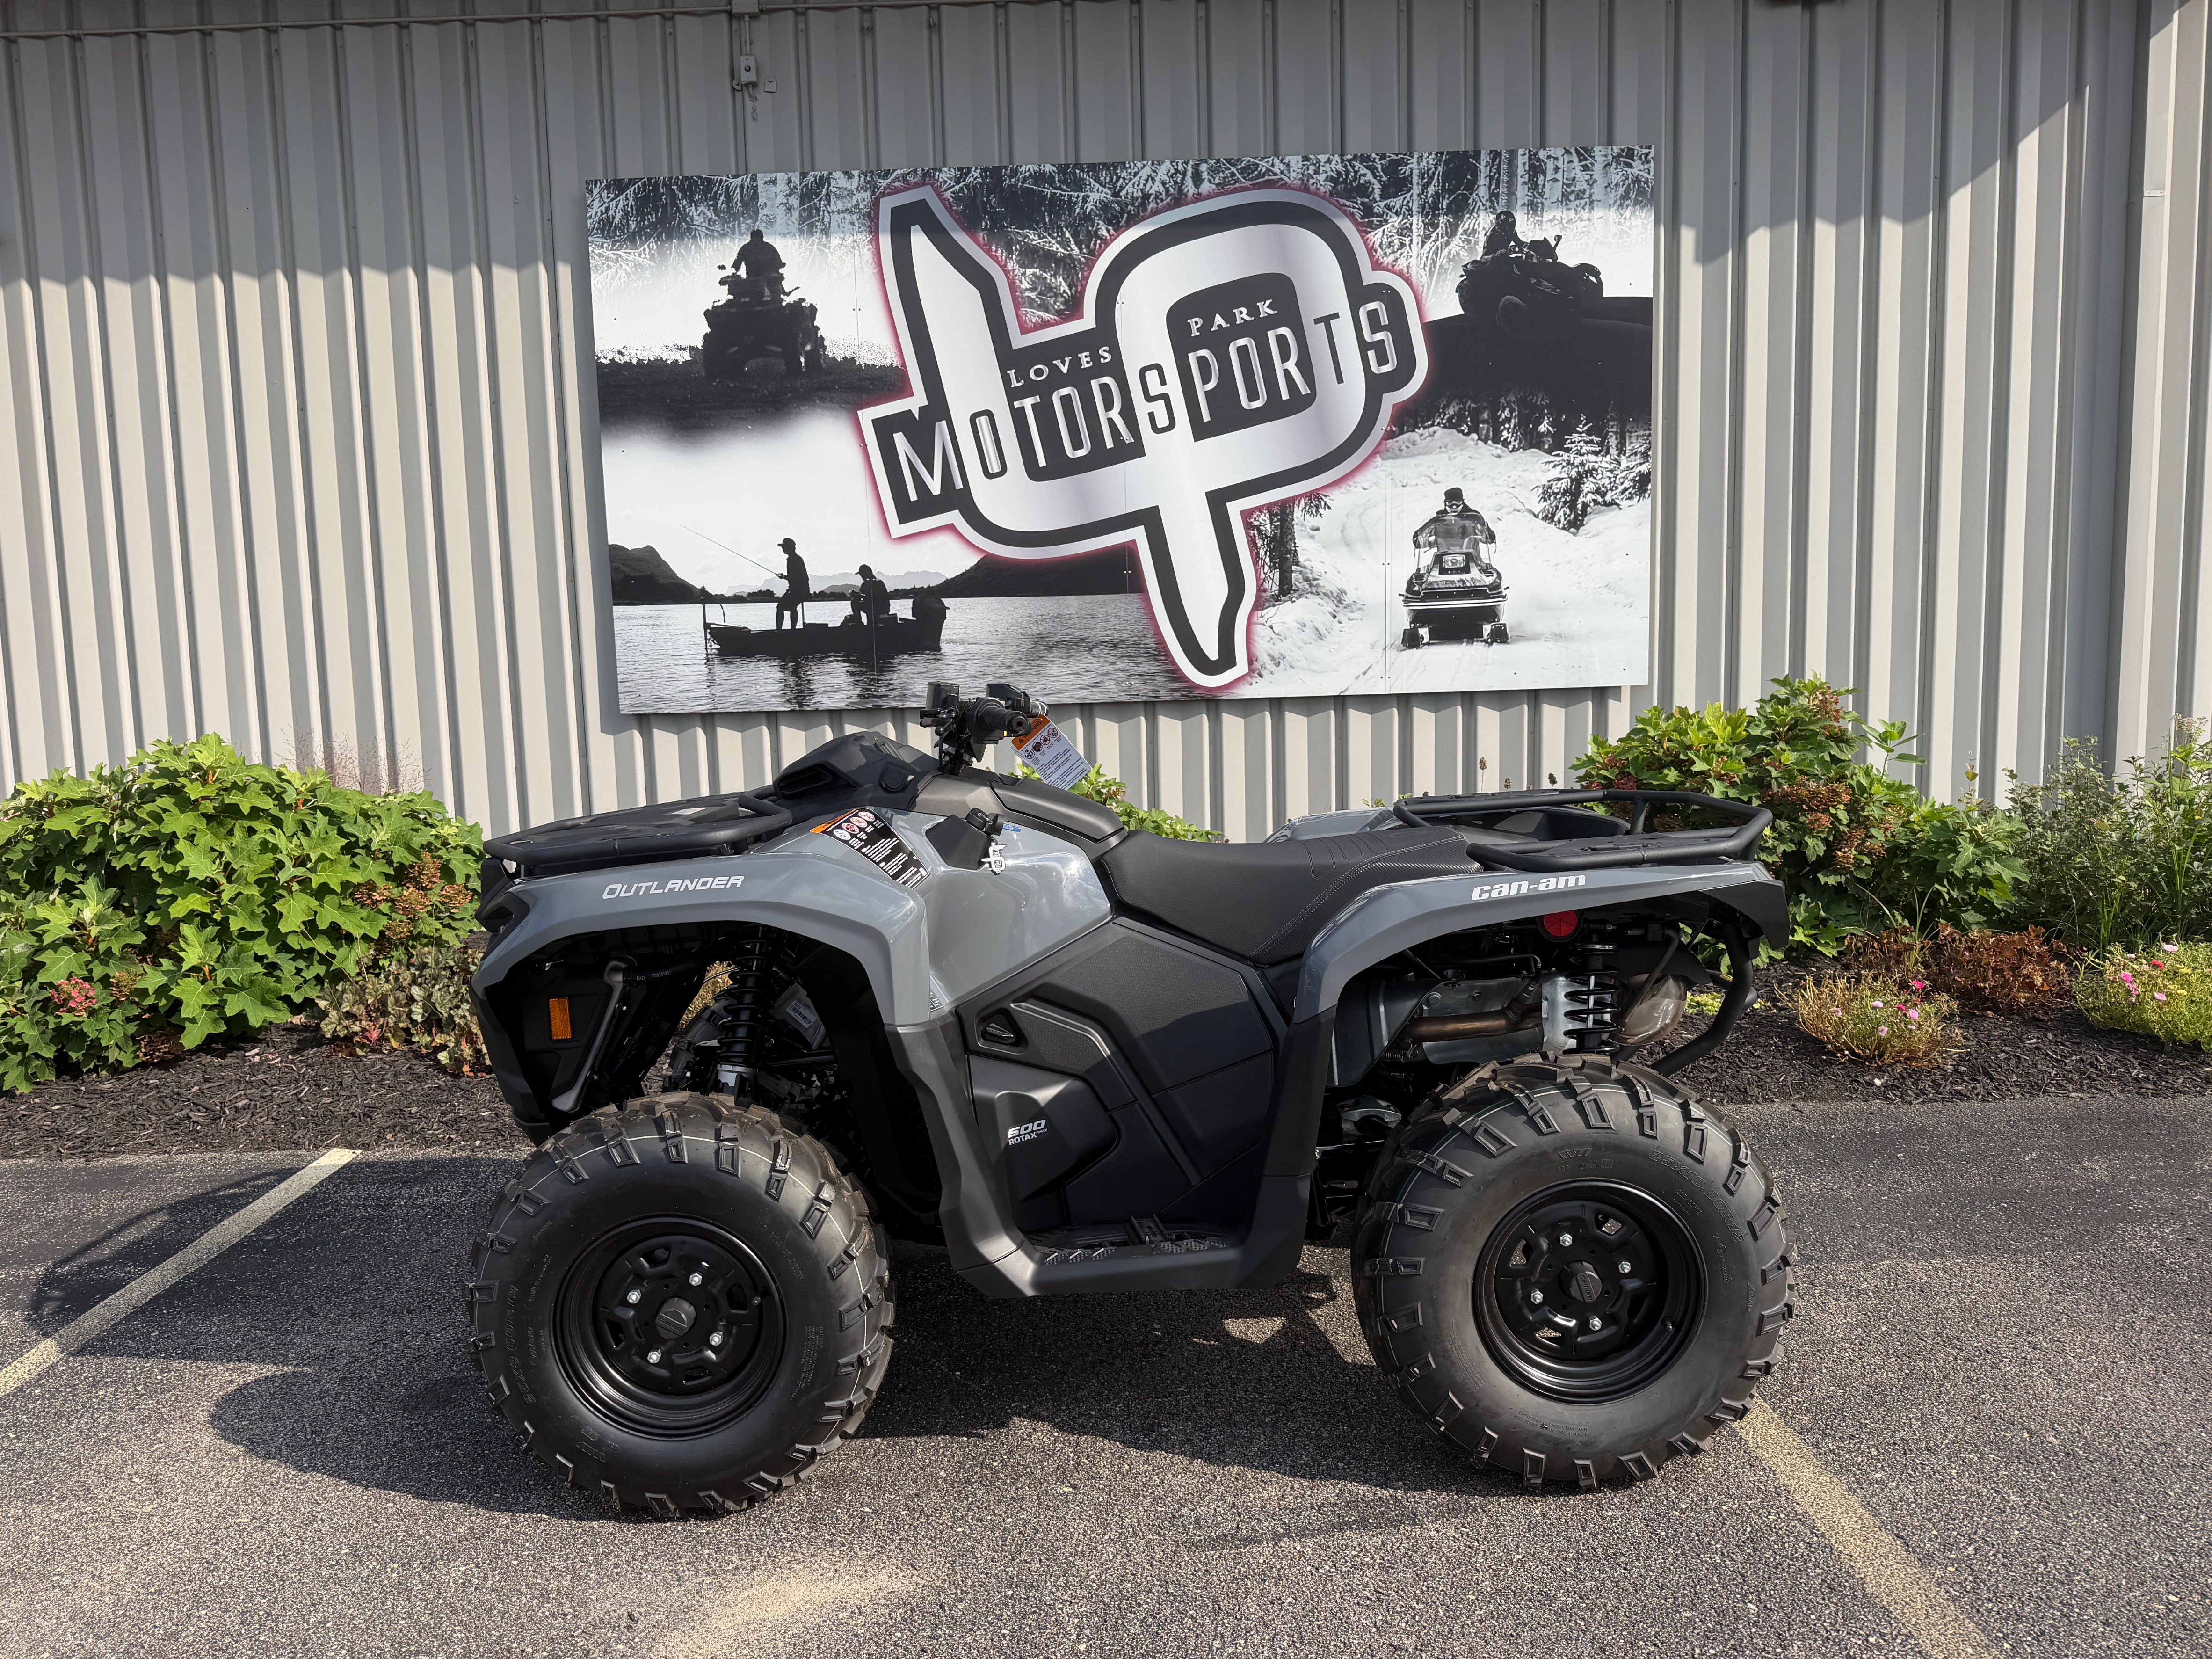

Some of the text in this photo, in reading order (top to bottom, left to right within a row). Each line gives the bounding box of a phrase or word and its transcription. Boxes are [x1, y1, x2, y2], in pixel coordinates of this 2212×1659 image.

[1188, 299, 1278, 336] PARK
[1008, 346, 1112, 387] LOVES
[894, 300, 1398, 502] MOTORSPORTS
[602, 875, 744, 899] OUTLANDER
[1472, 875, 1586, 901] can-am
[1008, 1119, 1046, 1139] 500
[1008, 1132, 1037, 1146] ROTAX
